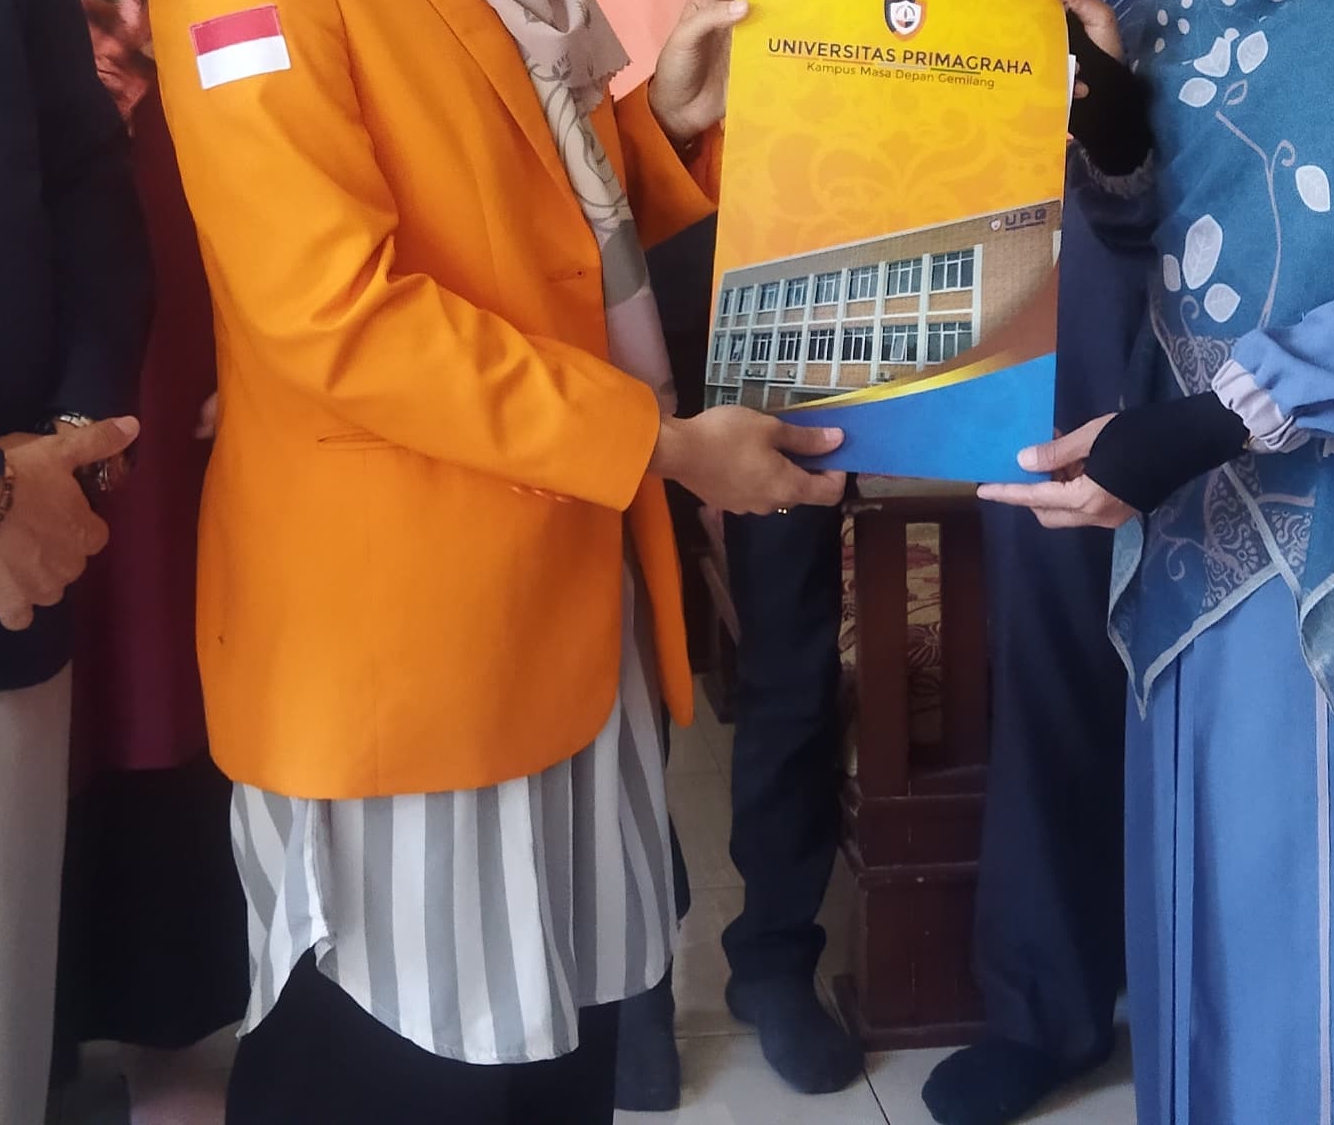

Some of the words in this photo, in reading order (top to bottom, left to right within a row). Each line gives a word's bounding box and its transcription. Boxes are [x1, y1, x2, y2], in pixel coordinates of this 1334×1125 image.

[768, 38, 895, 64] UNIVERSITAS
[902, 49, 1033, 76] PRIMAGRAHA
[806, 62, 857, 76] Kampus
[860, 66, 892, 79] Masa
[895, 69, 935, 84] Depan
[938, 72, 996, 90] Gemilang
